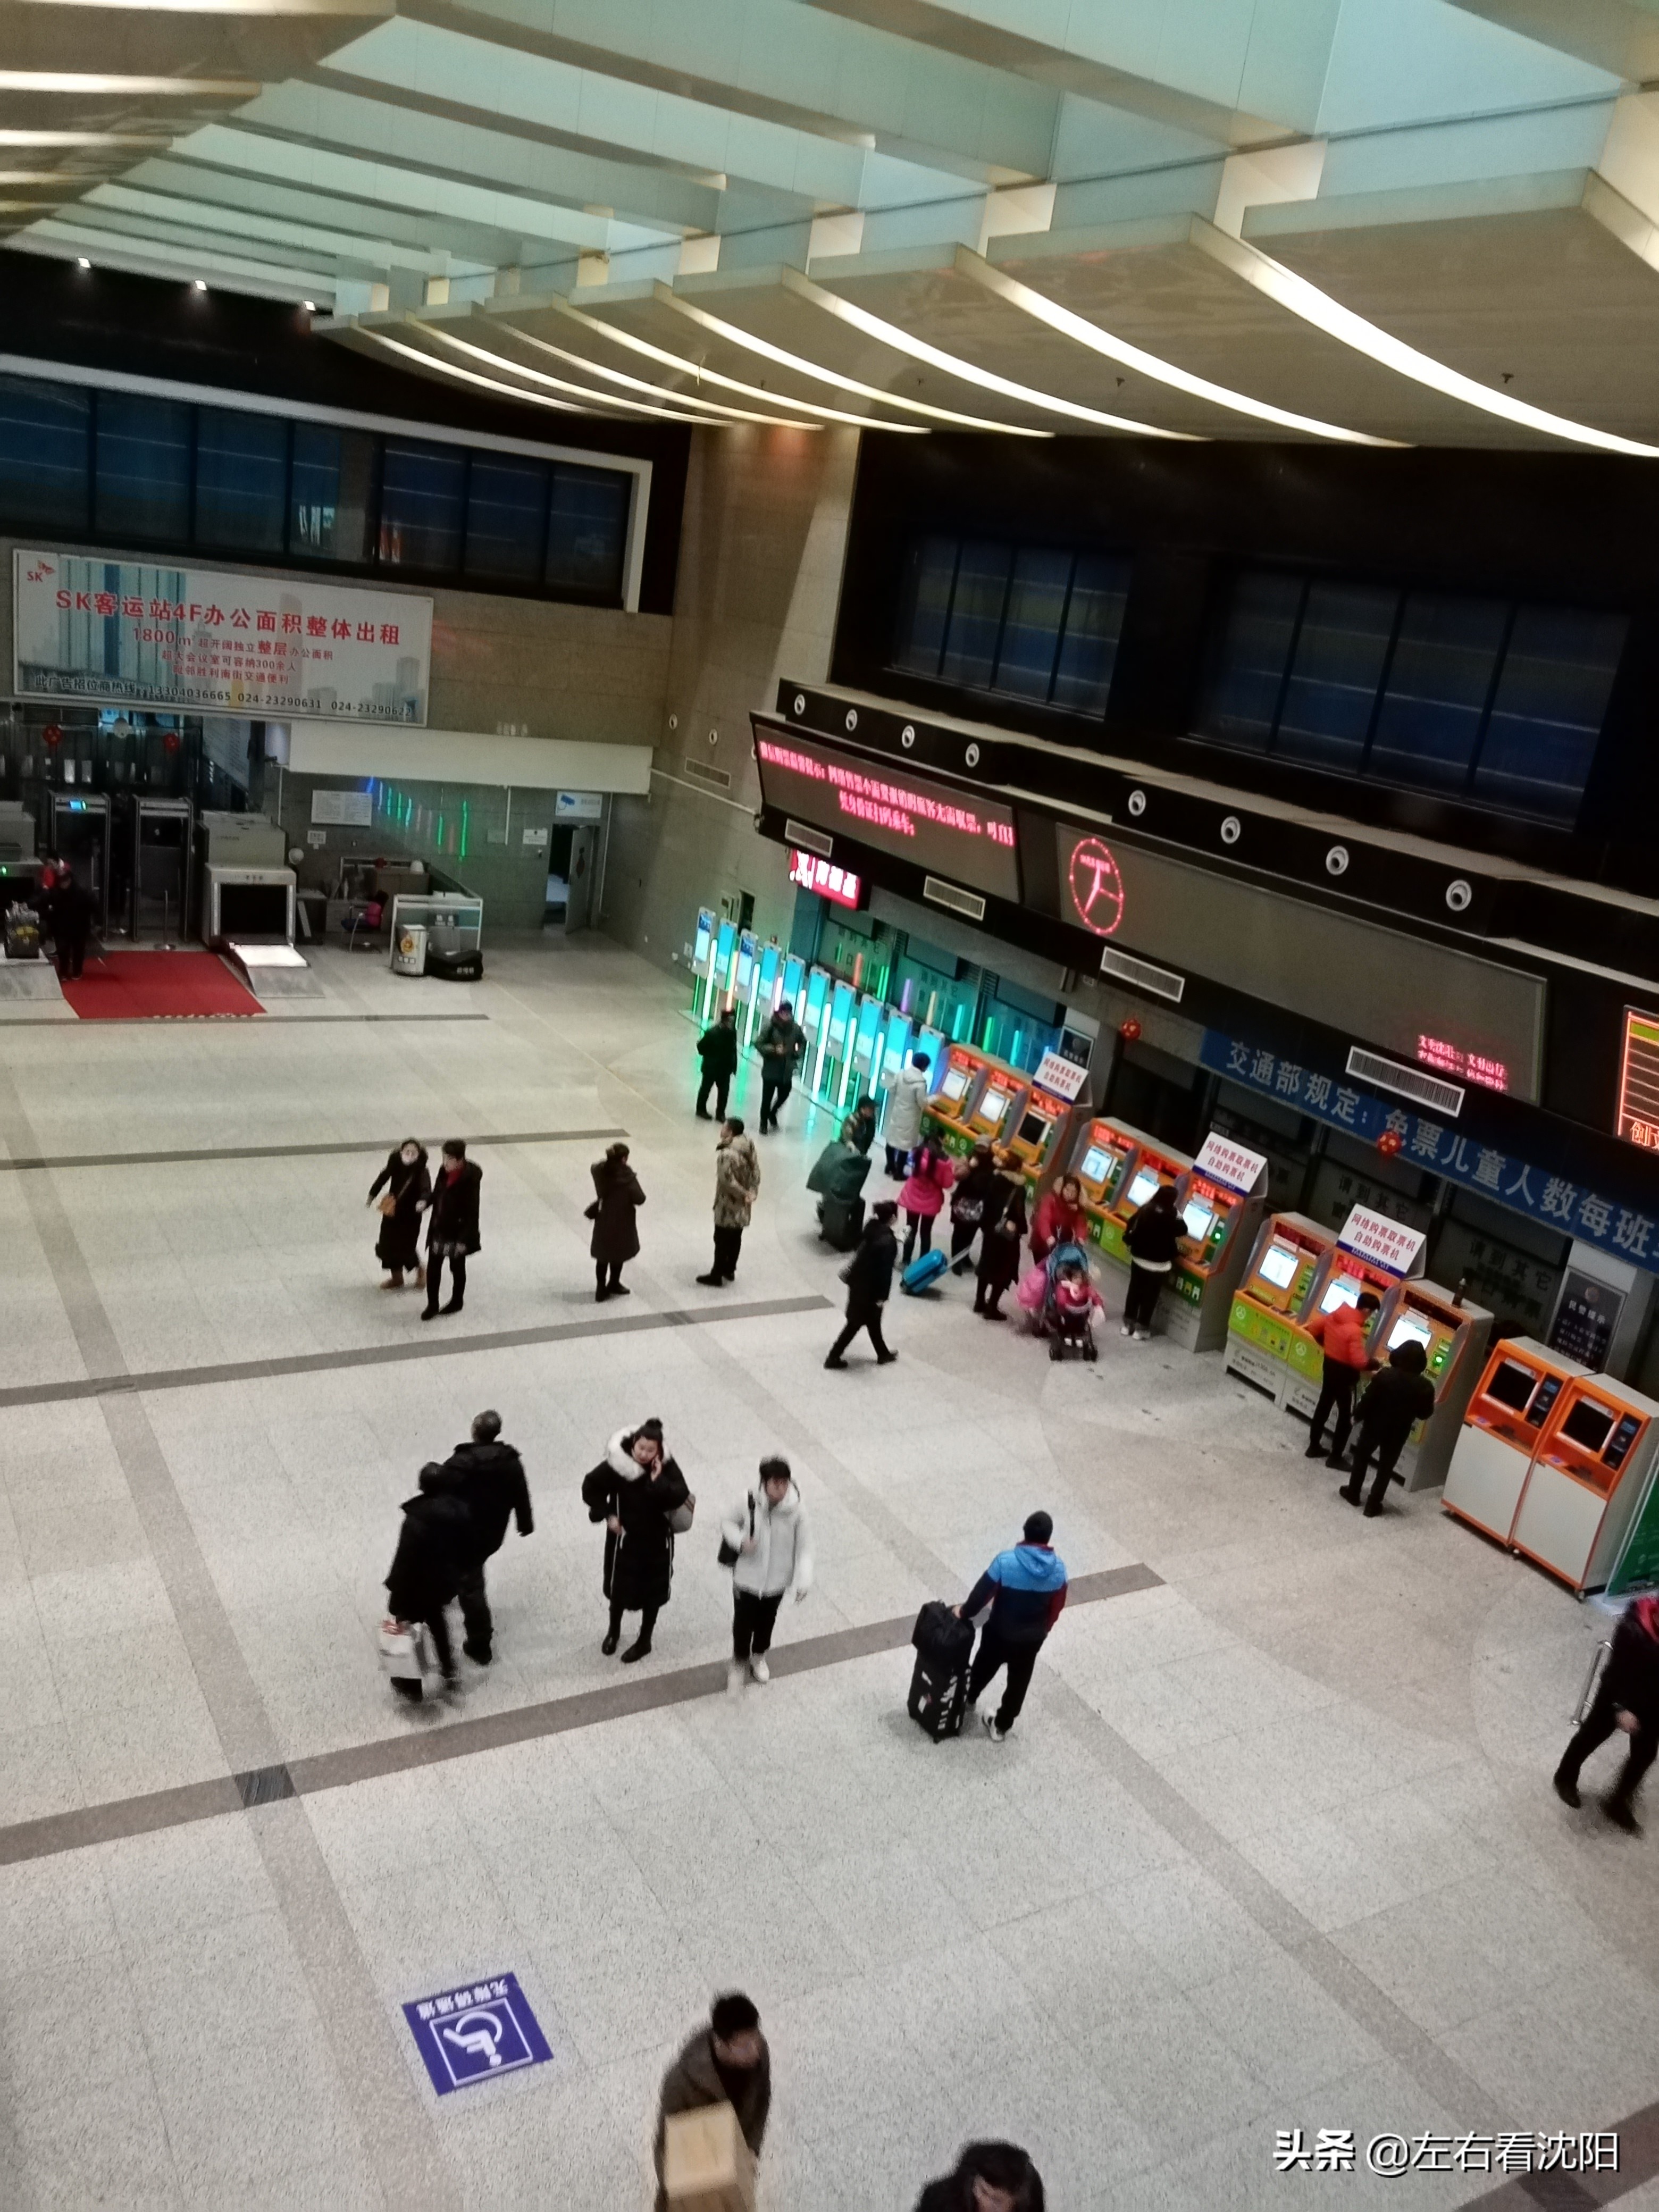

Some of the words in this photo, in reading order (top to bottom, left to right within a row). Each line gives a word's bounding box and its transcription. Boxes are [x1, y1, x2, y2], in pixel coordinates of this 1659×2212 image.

[27, 571, 43, 582] SK
[56, 590, 399, 646] SK客运站4F办公面积整体出租
[162, 650, 296, 672] 超大会议室可容纳300余人
[238, 693, 321, 709] 024-23290631
[331, 701, 411, 717] 024-23290622
[1206, 1139, 1259, 1174] 网络购票取票机
[1226, 1041, 1659, 1259] 交通部规定：免票儿童人数每班
[1207, 1157, 1245, 1182] 自助购票机
[1351, 1212, 1418, 1252] 网络购票取票机
[1354, 1230, 1400, 1262] 自助购票机
